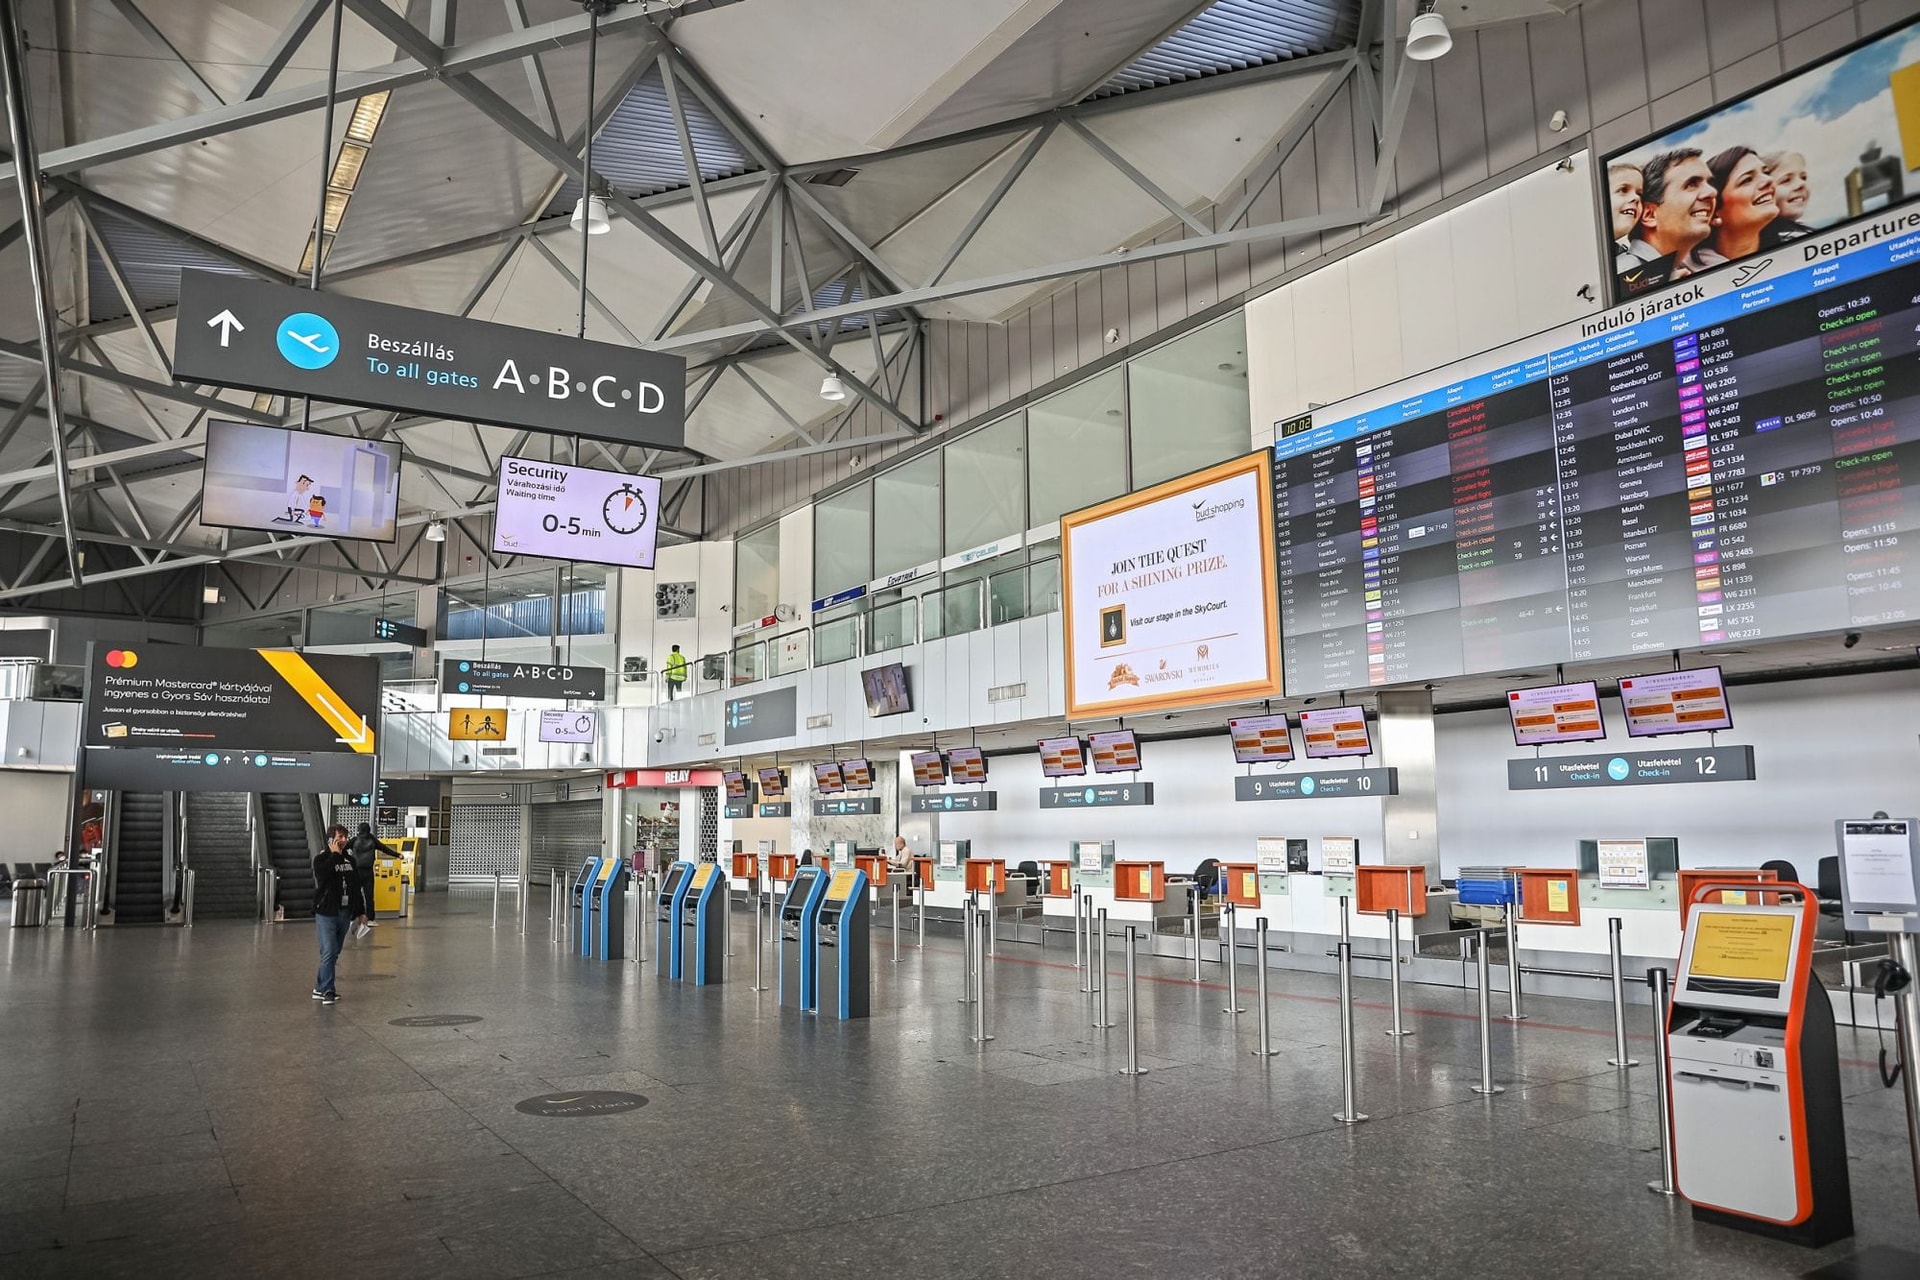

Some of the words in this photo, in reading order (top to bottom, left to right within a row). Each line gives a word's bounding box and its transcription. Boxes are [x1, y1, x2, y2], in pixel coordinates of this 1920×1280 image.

[1813, 276, 1836, 287] Status
[1741, 284, 1774, 299] Partnerek
[1743, 296, 1770, 310] Partners
[1818, 304, 1845, 318] Opens:
[1847, 296, 1870, 309] 10:30
[1582, 308, 1634, 337] Induló
[1641, 284, 1704, 322] járatok
[1672, 322, 1689, 332] Flight
[1820, 316, 1854, 331] Check-in
[1856, 309, 1877, 321] open
[1700, 332, 1710, 340] BA
[1711, 327, 1725, 337] 869
[368, 333, 454, 362] Beszállás
[1606, 339, 1638, 353] Destination
[1701, 344, 1711, 353] SU
[1712, 339, 1729, 349] 2031
[1702, 357, 1714, 365] W6
[1716, 351, 1734, 361] 2405
[367, 357, 389, 374] To
[396, 362, 419, 379] all
[427, 367, 478, 388] gates
[1553, 375, 1568, 385] 12:25
[1608, 358, 1630, 369] London
[1631, 352, 1644, 361] LHR
[1609, 370, 1634, 380] Moscow
[1635, 363, 1648, 373] SVO
[1704, 370, 1714, 378] LO
[1714, 365, 1728, 376] 536
[1610, 377, 1646, 392] Gothenburg
[1648, 371, 1662, 381] GOT
[1298, 418, 1310, 430] 02
[1785, 416, 1795, 424] DL
[1796, 410, 1816, 421] 9696
[1616, 440, 1647, 453] Stockholm
[1649, 435, 1663, 445] NYO
[1617, 452, 1652, 465] Amsterdam
[508, 462, 568, 484] Security
[1618, 467, 1635, 477] Leeds
[1636, 461, 1663, 473] Bradford
[1791, 469, 1799, 478] TP
[1801, 466, 1821, 475] 7979
[507, 478, 552, 490] Várakozási
[506, 489, 536, 500] Waiting
[538, 493, 555, 501] time
[1622, 504, 1645, 514] Munich
[542, 514, 581, 535] 0-5
[582, 528, 601, 537] min
[1624, 527, 1647, 538] Istanbul
[1719, 525, 1728, 533] FR
[1729, 522, 1747, 531] 6680
[1456, 539, 1478, 549] Check-in
[1479, 535, 1495, 544] closed
[1514, 541, 1521, 549] 59
[1844, 541, 1871, 553] Opens:
[1874, 537, 1897, 547] 11:50
[1111, 557, 1136, 574] JOIN
[1138, 550, 1164, 568] THE
[1167, 539, 1206, 563] QUEST
[1457, 550, 1479, 560] Check-in
[1480, 548, 1493, 556] open
[1098, 582, 1119, 598] FOR
[1122, 580, 1129, 592] A
[1132, 567, 1182, 589] SHINING
[1187, 555, 1228, 576] PRIZE.
[1628, 577, 1663, 588] Manchester
[1130, 619, 1144, 627] Visit
[1156, 612, 1173, 622] stage
[1182, 607, 1193, 616] the
[1194, 600, 1227, 614] SkyCourt.
[473, 662, 501, 670] Beszállás
[491, 671, 509, 679] gates
[1145, 669, 1183, 683] SWAROVSKI
[106, 676, 152, 687] Prémium
[220, 682, 272, 694] kártyájával
[104, 688, 149, 699] ingyenes
[162, 691, 190, 701] Gyors
[194, 692, 213, 700] Sáv
[215, 694, 271, 704] használata!
[1534, 766, 1548, 782] 11
[1559, 763, 1600, 772] Utasfelvétel
[1637, 758, 1681, 767] Utasfelvétel
[1695, 756, 1716, 775] 12
[1570, 772, 1600, 781] Check-in
[1638, 769, 1670, 777] Check-in
[665, 770, 690, 784] RELAY
[1254, 782, 1262, 795] 9
[1356, 776, 1371, 790] 10
[1276, 787, 1296, 795] Check-in
[1054, 793, 1058, 803] 7
[1123, 789, 1129, 800] 8
[821, 804, 824, 812] 3
[861, 802, 865, 810] 4
[921, 800, 925, 809] 5
[972, 797, 977, 807] 6
